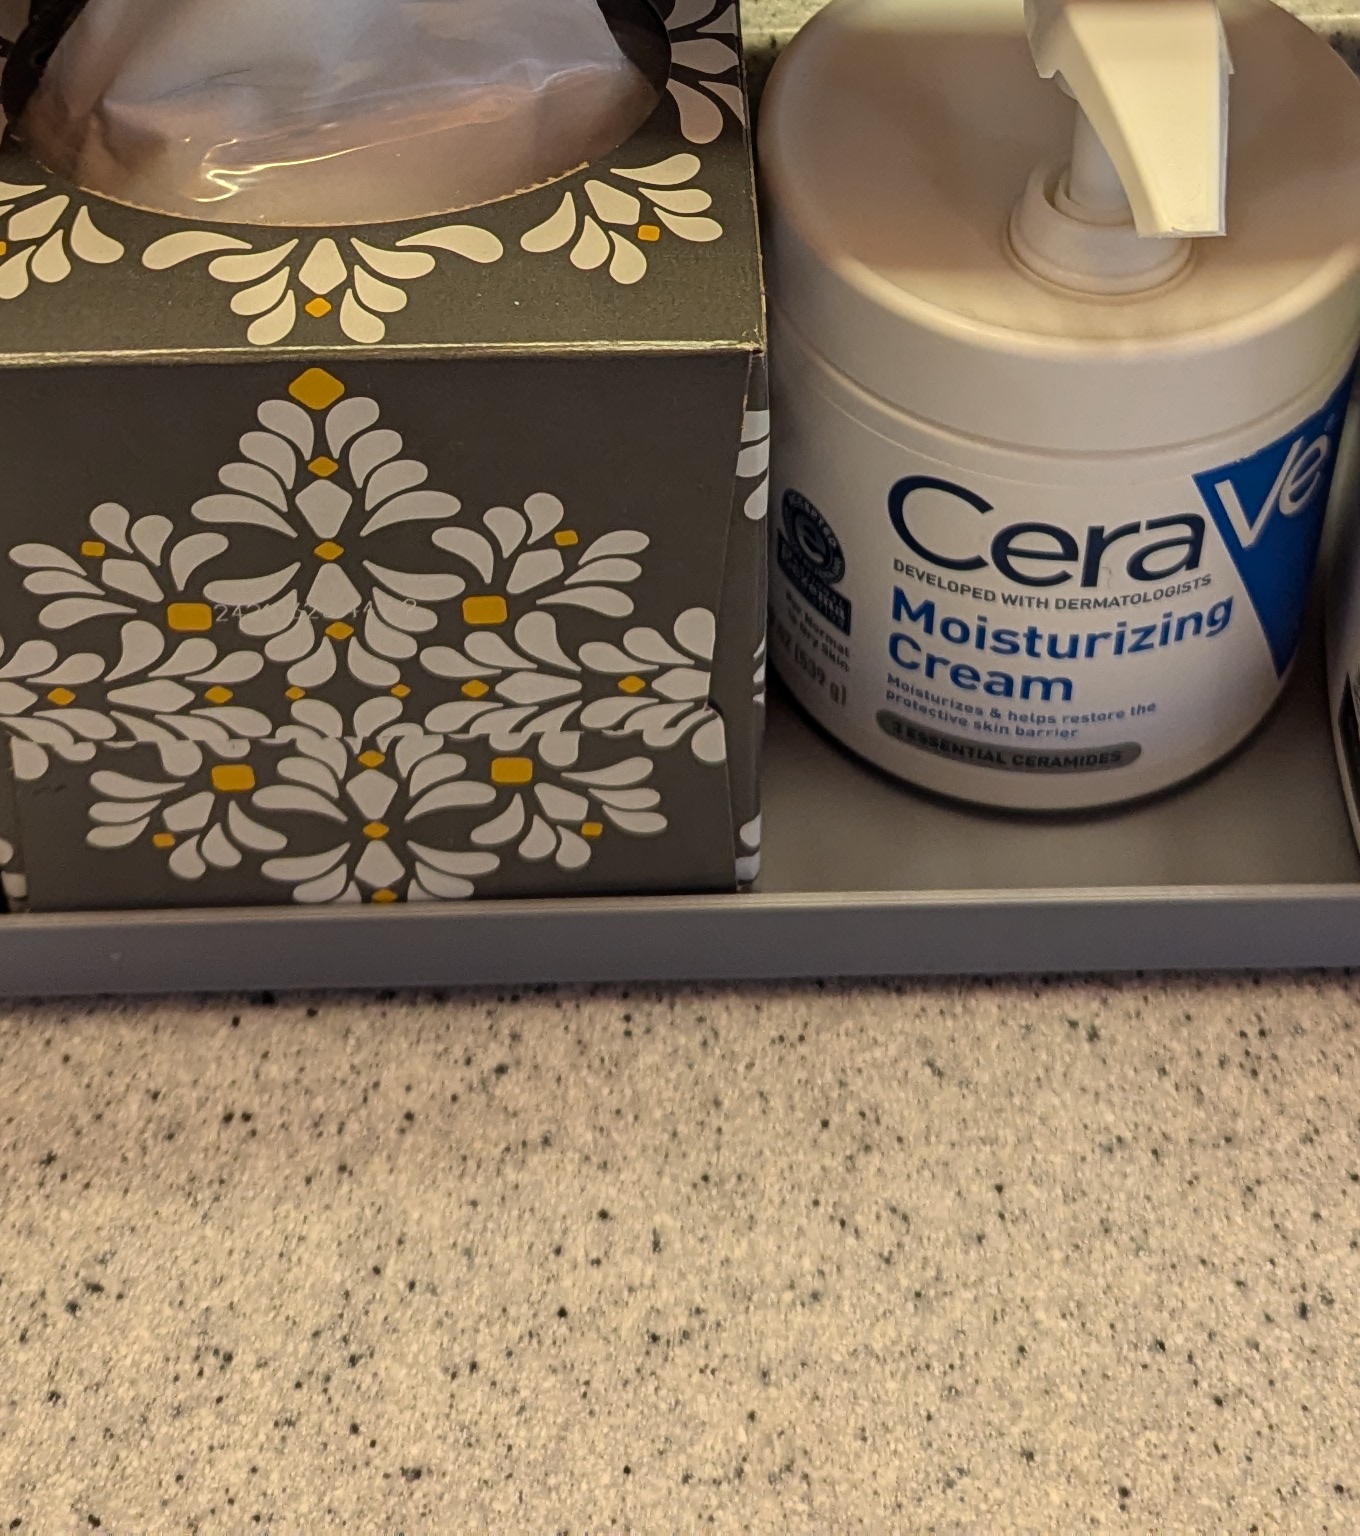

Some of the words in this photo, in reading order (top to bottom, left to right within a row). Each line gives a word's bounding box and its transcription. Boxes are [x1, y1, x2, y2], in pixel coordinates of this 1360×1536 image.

[887, 430, 1330, 588] CeraVe
[892, 558, 996, 601] DEVELOPED
[1001, 592, 1049, 609] WITH
[1054, 574, 1212, 609] DERMATOLOGISTS
[891, 585, 1234, 659] Moisturizing
[888, 632, 1074, 701] Cream
[885, 689, 968, 727] protective
[973, 719, 1010, 735] skin
[1015, 726, 1079, 739] barrier
[887, 673, 984, 716] Moisturizes
[989, 707, 1002, 719] &
[1007, 710, 1056, 725] helps
[1062, 710, 1126, 724] restore
[1130, 702, 1157, 716] the
[906, 726, 1005, 764] ESSENTIAL
[1012, 750, 1122, 768] CERAMIDES
